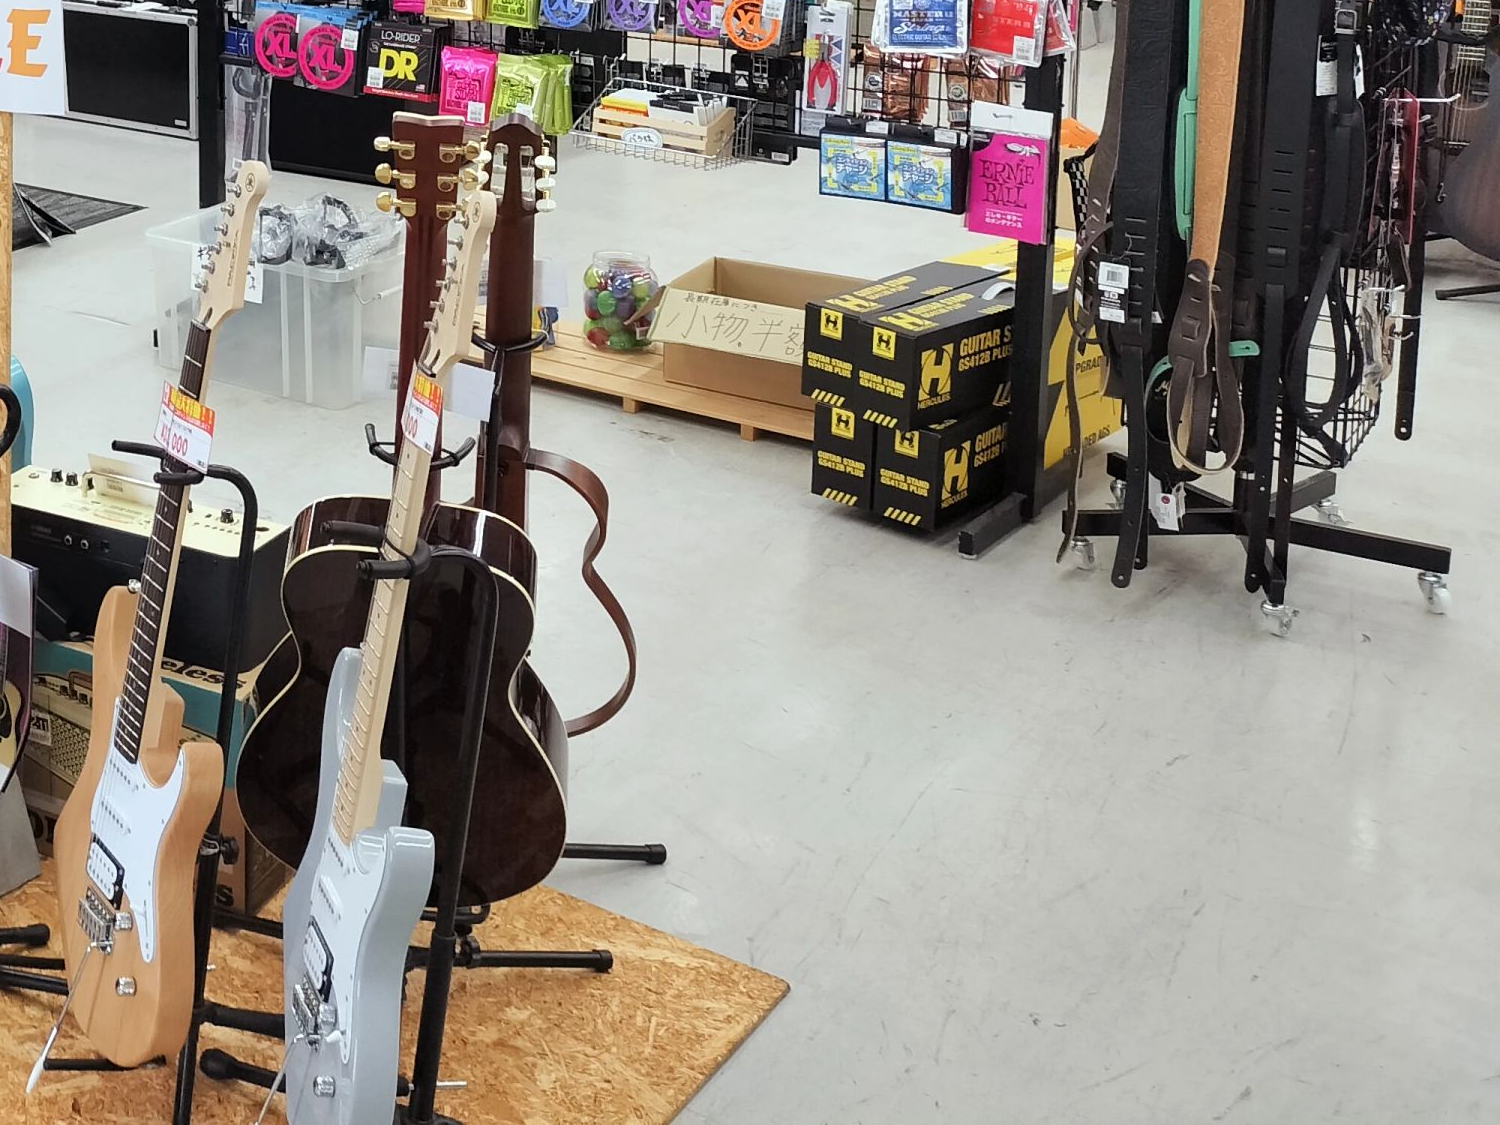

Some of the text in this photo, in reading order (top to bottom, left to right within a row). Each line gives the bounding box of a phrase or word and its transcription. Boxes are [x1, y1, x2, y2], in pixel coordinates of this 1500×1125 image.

[737, 10, 767, 35] XL
[892, 10, 943, 18] MASTER
[265, 32, 297, 59] XL
[381, 30, 421, 43] LO-RIDER
[309, 43, 342, 72] XL
[379, 48, 419, 81] DR
[836, 164, 869, 175] チャージ
[902, 172, 935, 184] チャージ
[980, 158, 1035, 186] ERNIE
[981, 181, 1028, 209] BALL
[959, 324, 1011, 356] GUITAR S
[807, 350, 853, 371] GUITAR STAND
[858, 370, 906, 391] GUITAR STAND
[917, 393, 951, 411] HERCULES
[817, 450, 866, 471] GUITAR STAND
[880, 468, 930, 489] GUITAR STAND
[161, 657, 248, 690] eless
